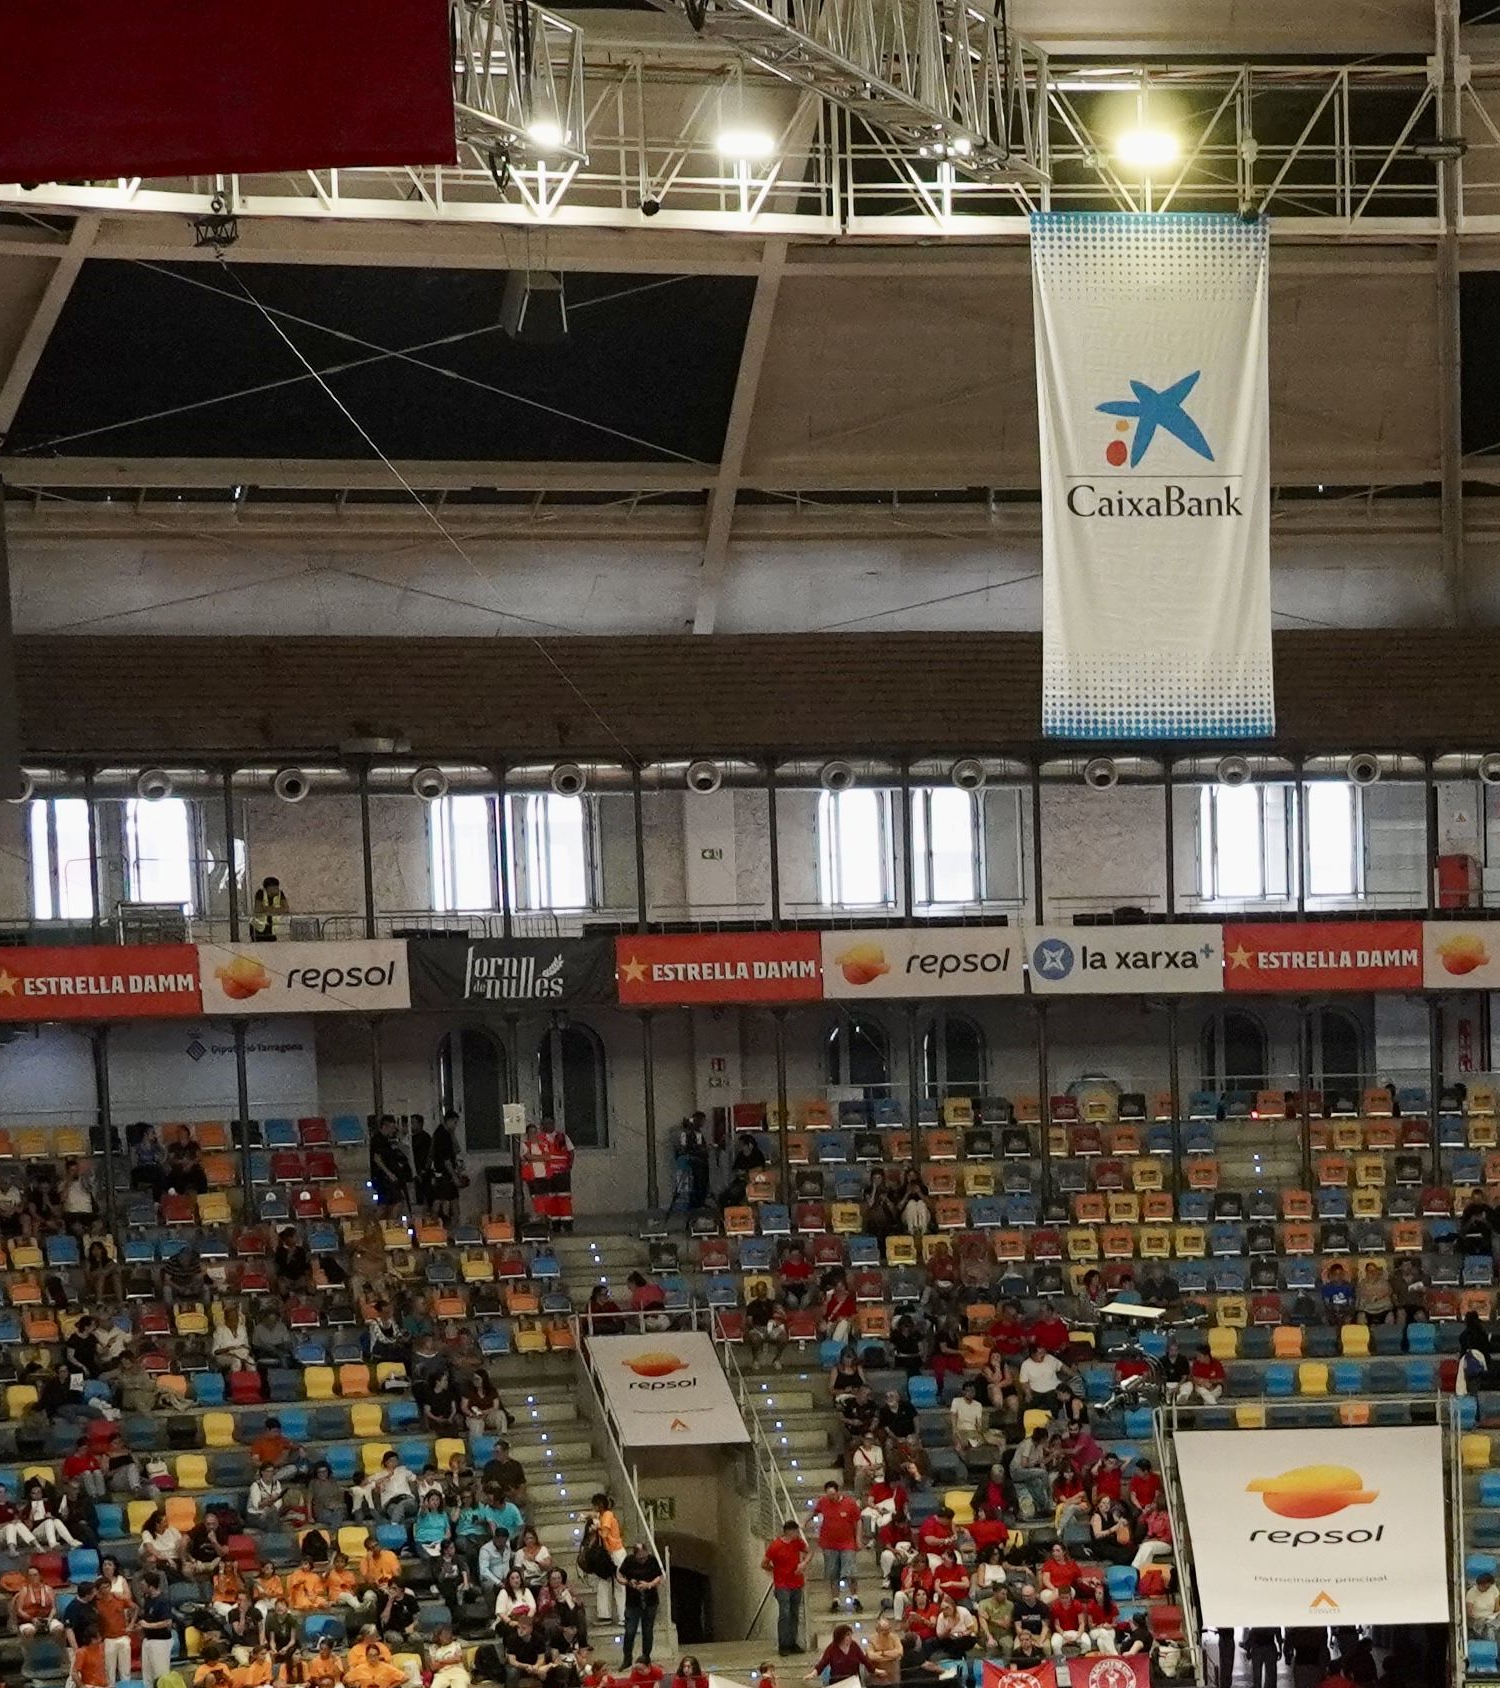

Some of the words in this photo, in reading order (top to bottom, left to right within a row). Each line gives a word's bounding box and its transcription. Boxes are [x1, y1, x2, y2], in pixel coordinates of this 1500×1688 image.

[1066, 484, 1244, 519] CaixaBank
[905, 947, 1010, 982] repsol
[1081, 944, 1107, 971] la
[1257, 948, 1353, 970] ESTRELLA
[1356, 947, 1419, 968] DAMM
[286, 960, 396, 995] repsol
[652, 960, 751, 982] ESTRELLA
[753, 959, 817, 980] DAMM
[24, 975, 126, 997] ESTRELLA
[128, 973, 195, 995] DAMM
[628, 1377, 698, 1392] repsol
[1249, 1524, 1385, 1548] repsol
